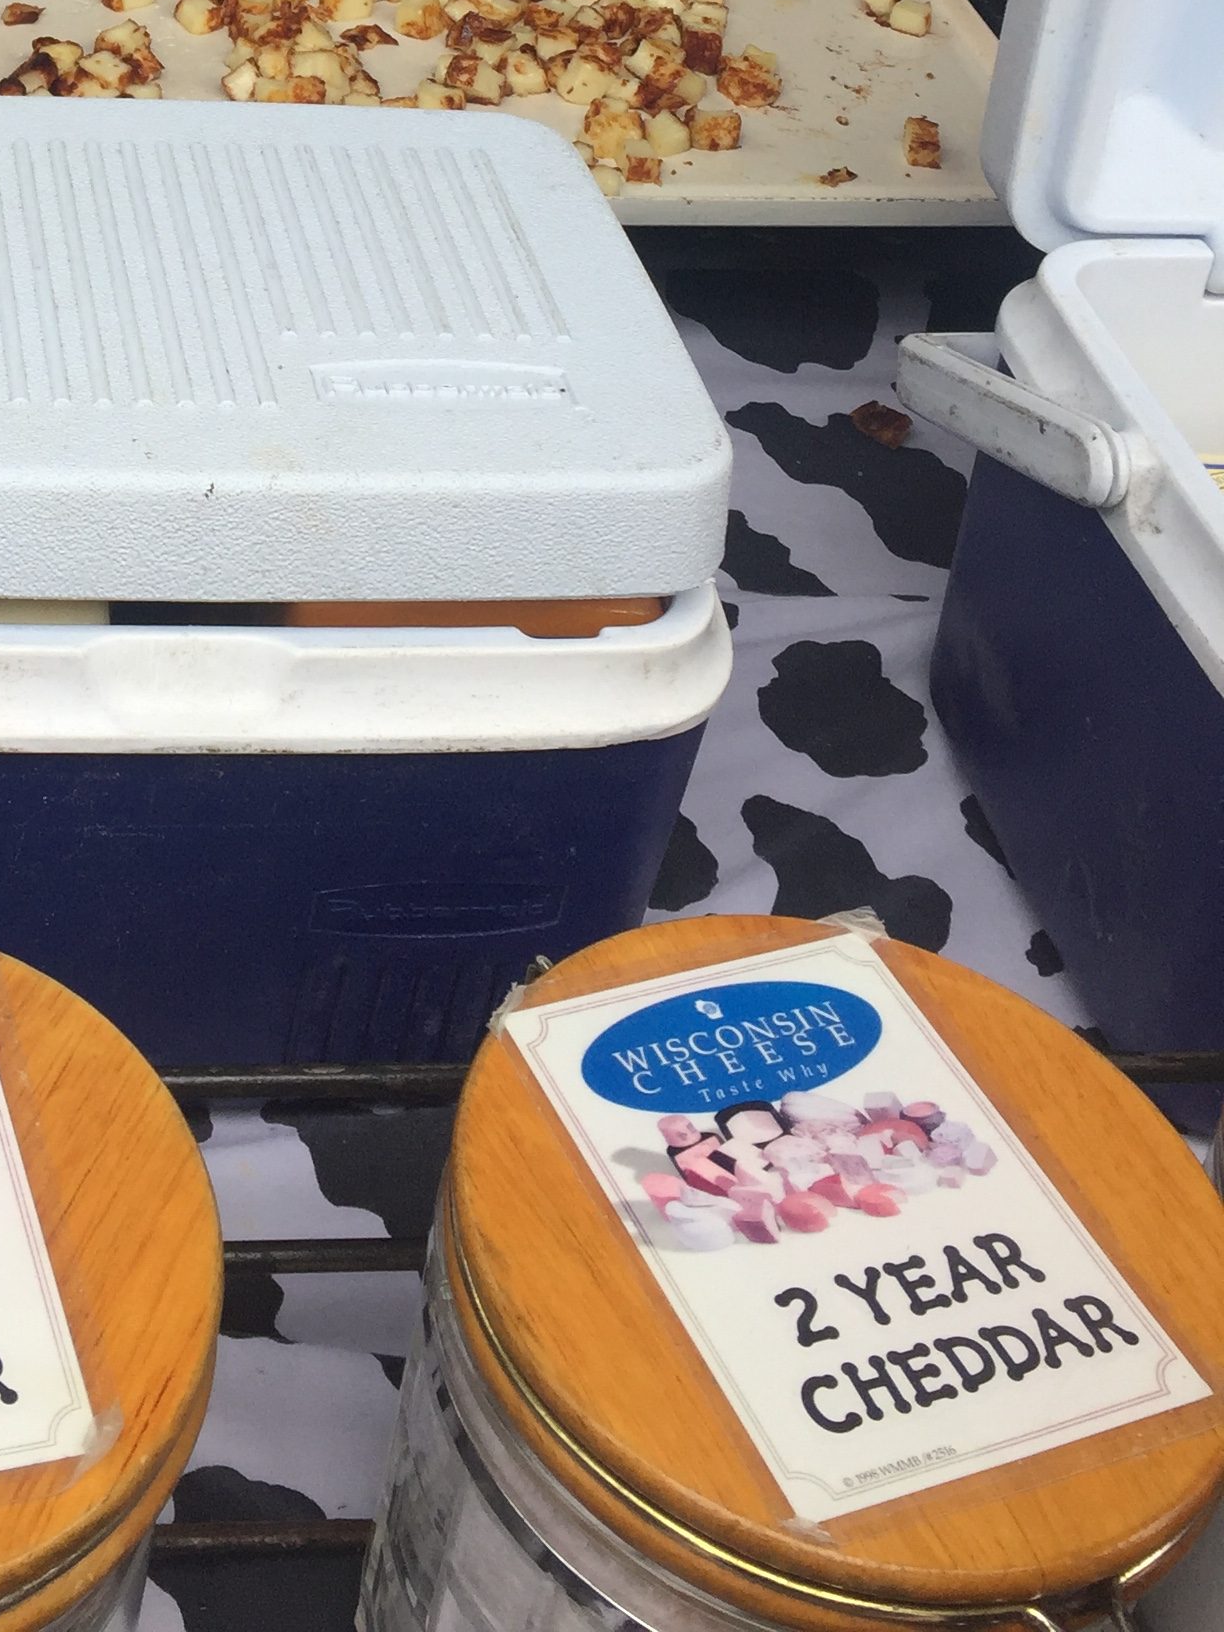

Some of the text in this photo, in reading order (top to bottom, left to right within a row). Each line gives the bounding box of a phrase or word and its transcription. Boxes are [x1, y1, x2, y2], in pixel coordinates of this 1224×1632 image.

[611, 1001, 842, 1074] WISCONSIN
[632, 1024, 856, 1094] CHEESE
[698, 1062, 829, 1103] Taste Why
[774, 1233, 1046, 1347] 2 YEAR
[800, 1295, 1139, 1434] CHEDDAR
[878, 1455, 921, 1476] WMMB
